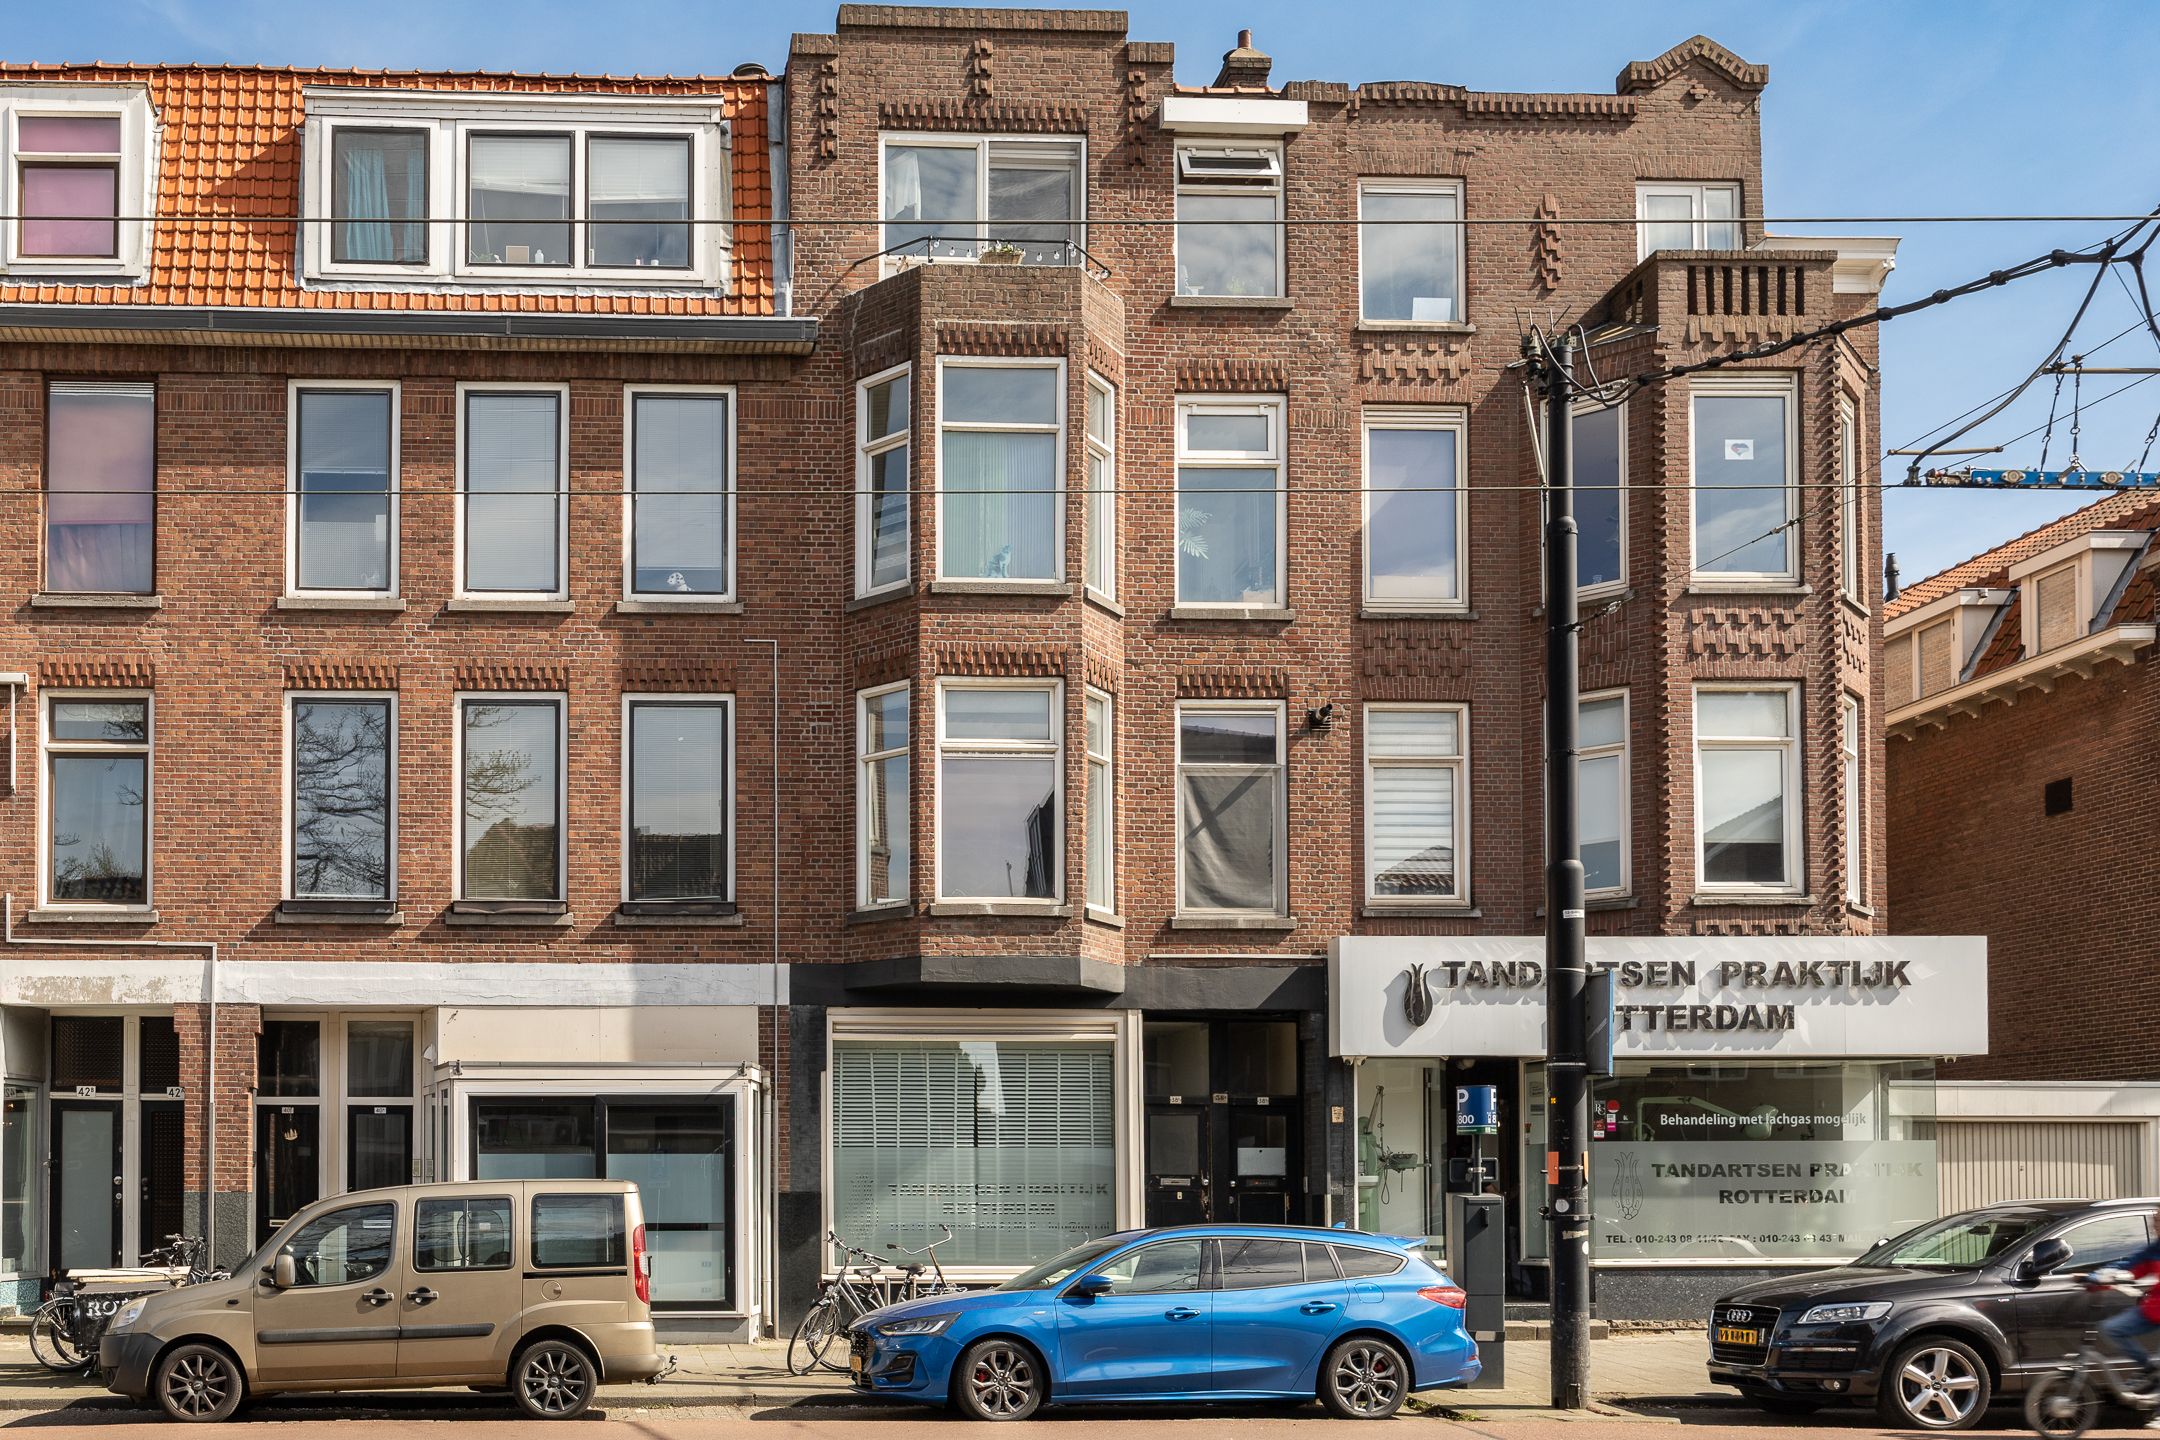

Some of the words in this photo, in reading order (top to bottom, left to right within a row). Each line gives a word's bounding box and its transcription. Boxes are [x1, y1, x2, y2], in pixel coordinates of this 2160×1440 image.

[1440, 960, 1696, 987] TANDTSEN
[1719, 960, 1912, 987] PRAKTIJK
[1613, 1004, 1795, 1031] TTERDAM
[1457, 1089, 1469, 1111] P
[1659, 1113, 1736, 1127] Behandeling
[1739, 1114, 1762, 1125] met
[1765, 1113, 1811, 1128] lachgas
[1813, 1113, 1867, 1128] mogelijk
[1651, 1163, 1802, 1178] TANDARTSEN
[1718, 1189, 1856, 1204] ROTTERDAM
[1605, 1235, 1626, 1243] TEL
[1635, 1235, 1677, 1243] 010-243
[1759, 1234, 1801, 1243] 010-243
[1819, 1234, 1833, 1243] 43
